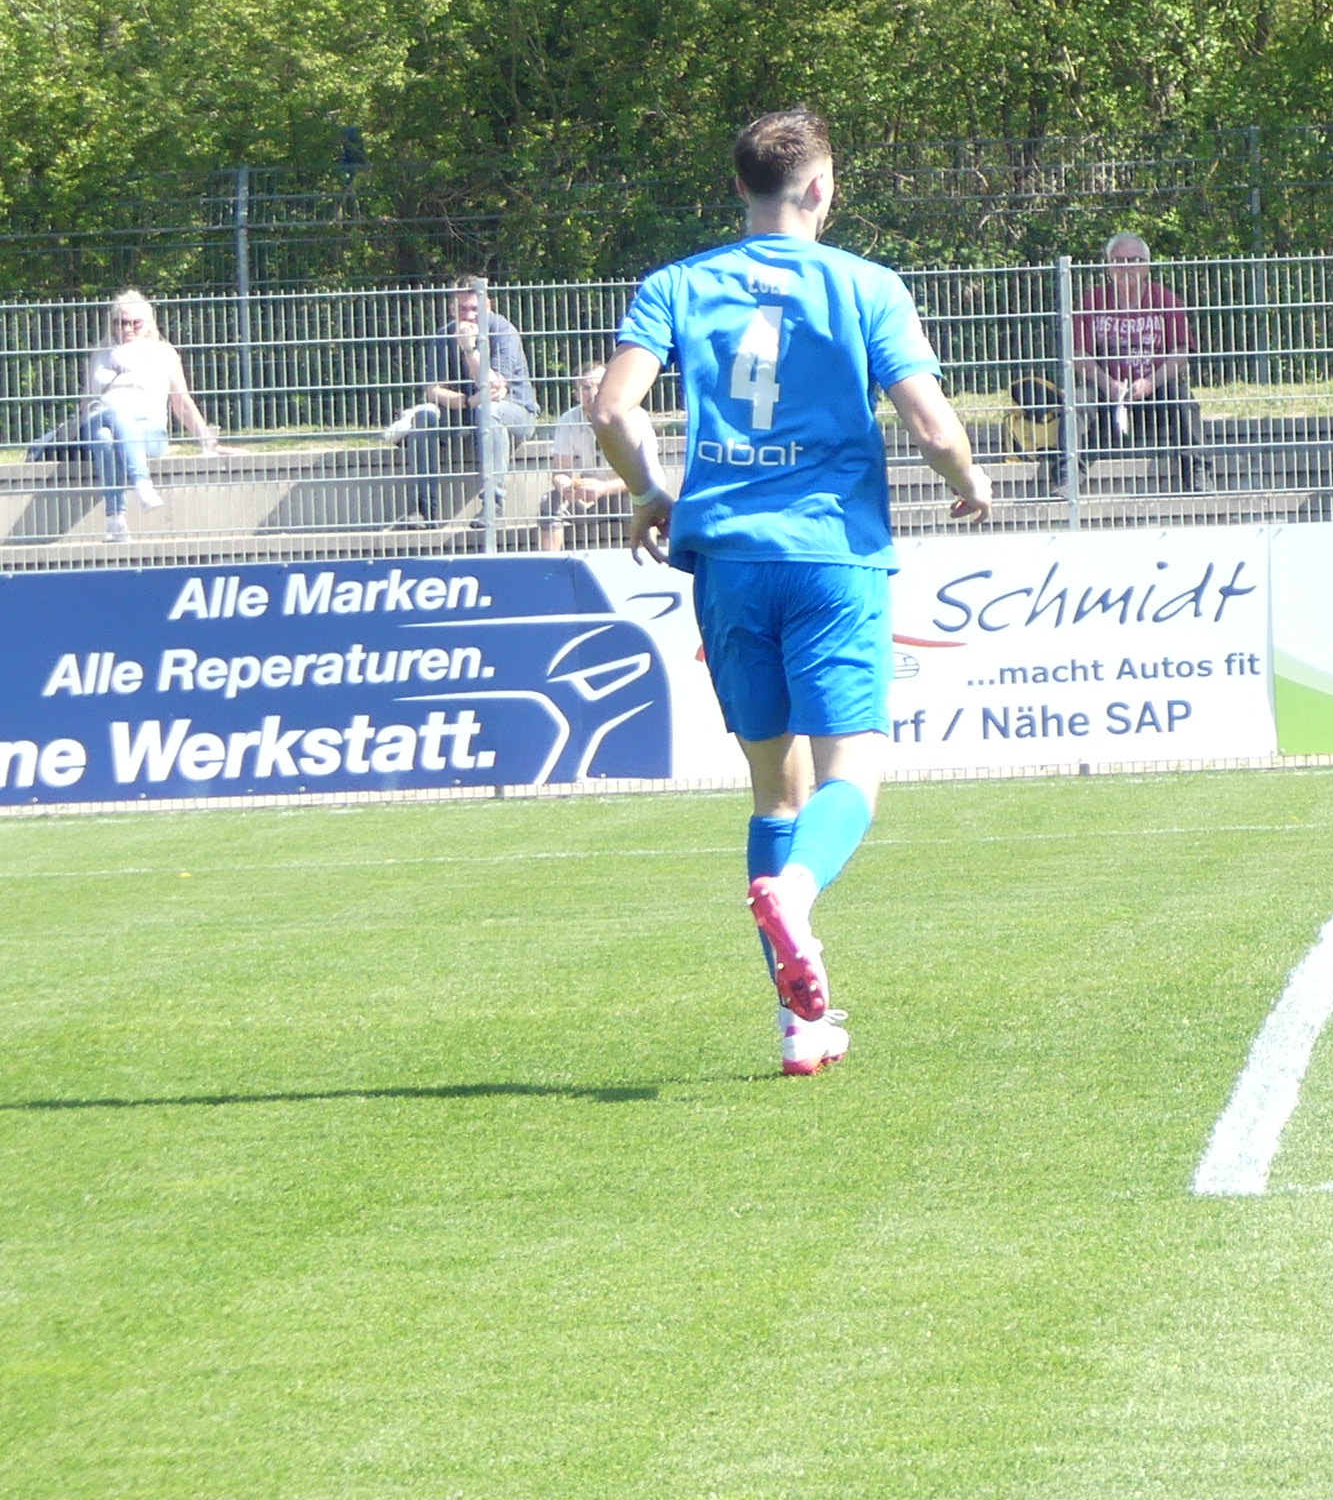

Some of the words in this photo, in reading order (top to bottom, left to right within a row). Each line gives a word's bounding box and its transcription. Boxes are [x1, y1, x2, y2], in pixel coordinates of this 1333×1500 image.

[730, 305, 784, 430] 4
[698, 438, 804, 466] abat
[169, 576, 269, 621] Alle
[282, 568, 493, 616] Marken.
[932, 560, 1258, 634] Schmidt
[43, 650, 144, 698] Alle
[157, 643, 496, 698] Reperaturen.
[967, 659, 1105, 686] ...macht
[1115, 656, 1213, 681] Autos
[1224, 652, 1261, 676] fit
[110, 709, 497, 784] Werkstatt.
[982, 705, 1090, 740] Nähe
[1106, 700, 1192, 735] SAP
